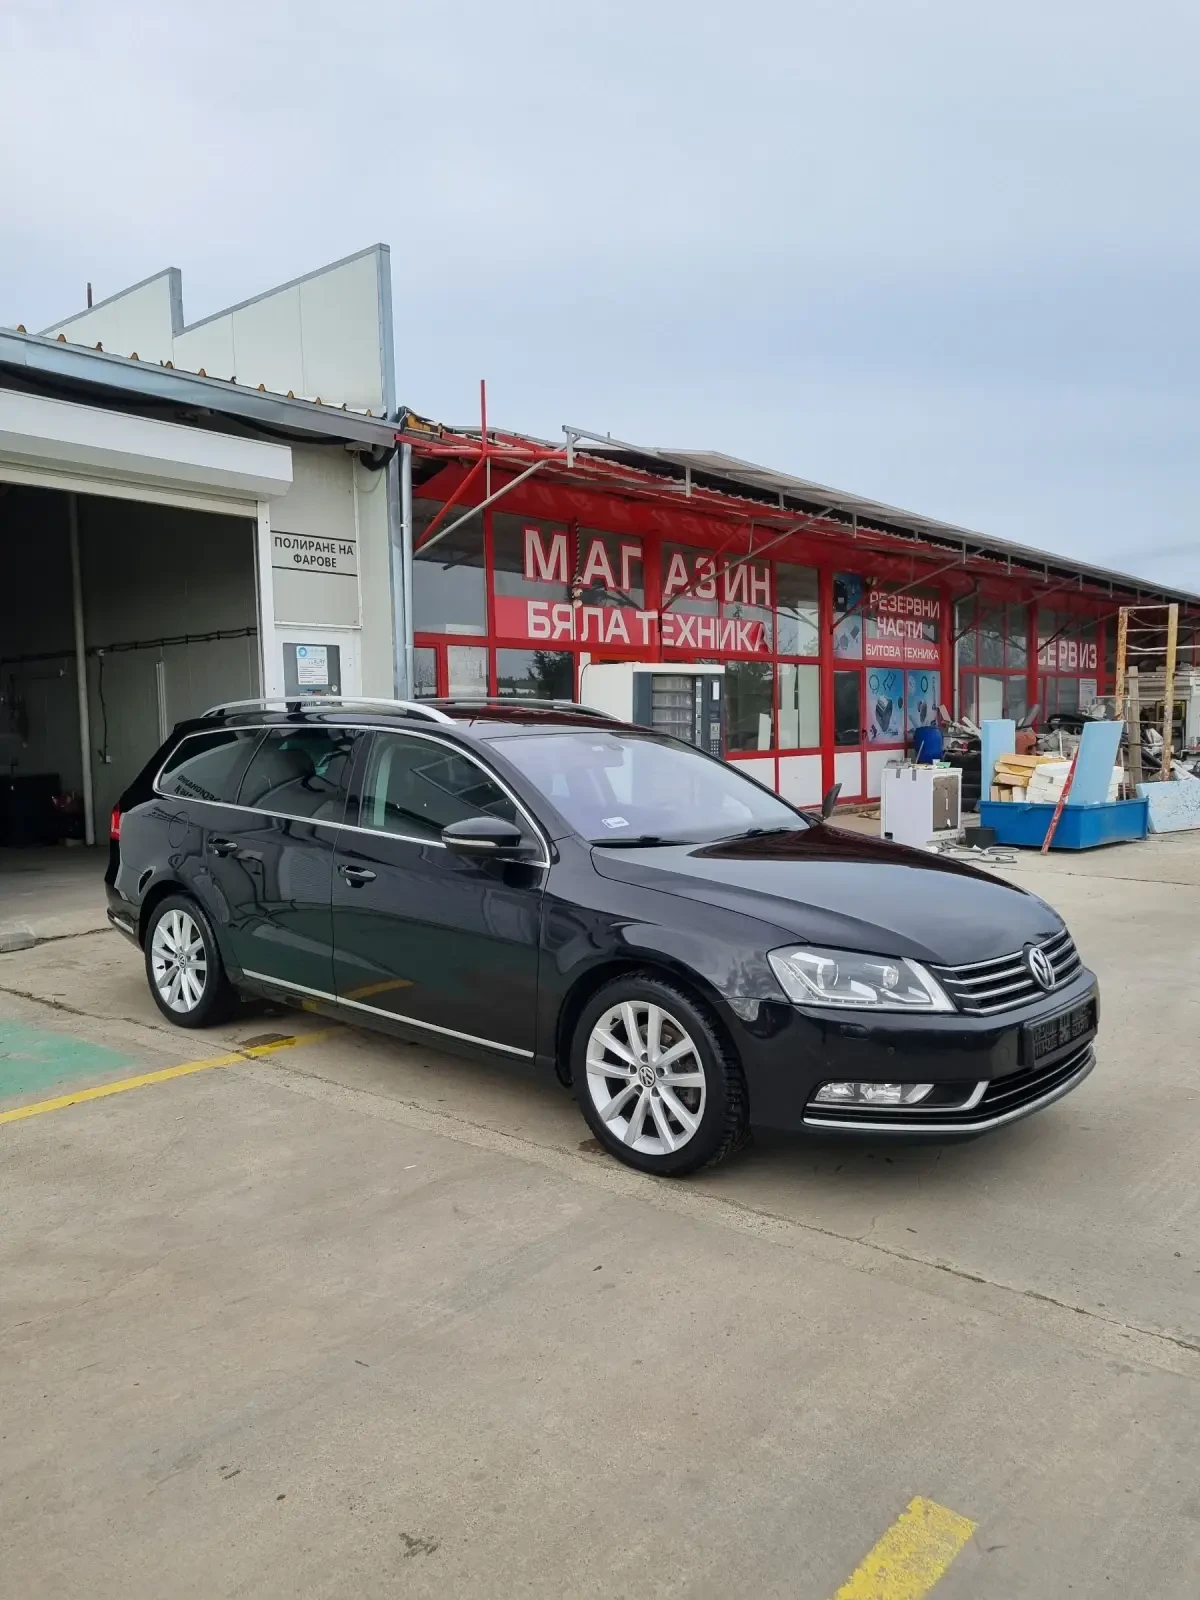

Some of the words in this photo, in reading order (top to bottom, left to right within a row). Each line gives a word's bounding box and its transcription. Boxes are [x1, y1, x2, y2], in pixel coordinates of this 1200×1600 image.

[274, 536, 337, 554] ПОЛИРАНЕ
[338, 544, 354, 556] НА
[293, 553, 337, 568] ФАРОВЕ
[869, 591, 940, 619] РЕЗЕРВНИ
[527, 601, 630, 644] БЯЛА
[636, 609, 772, 654] ТЕХНИКА
[877, 616, 923, 639] ЧАСТИ
[865, 643, 901, 657] БИТОВА
[904, 647, 940, 660] ТЕХНИКА
[1037, 637, 1097, 669] СЕРВИЗ
